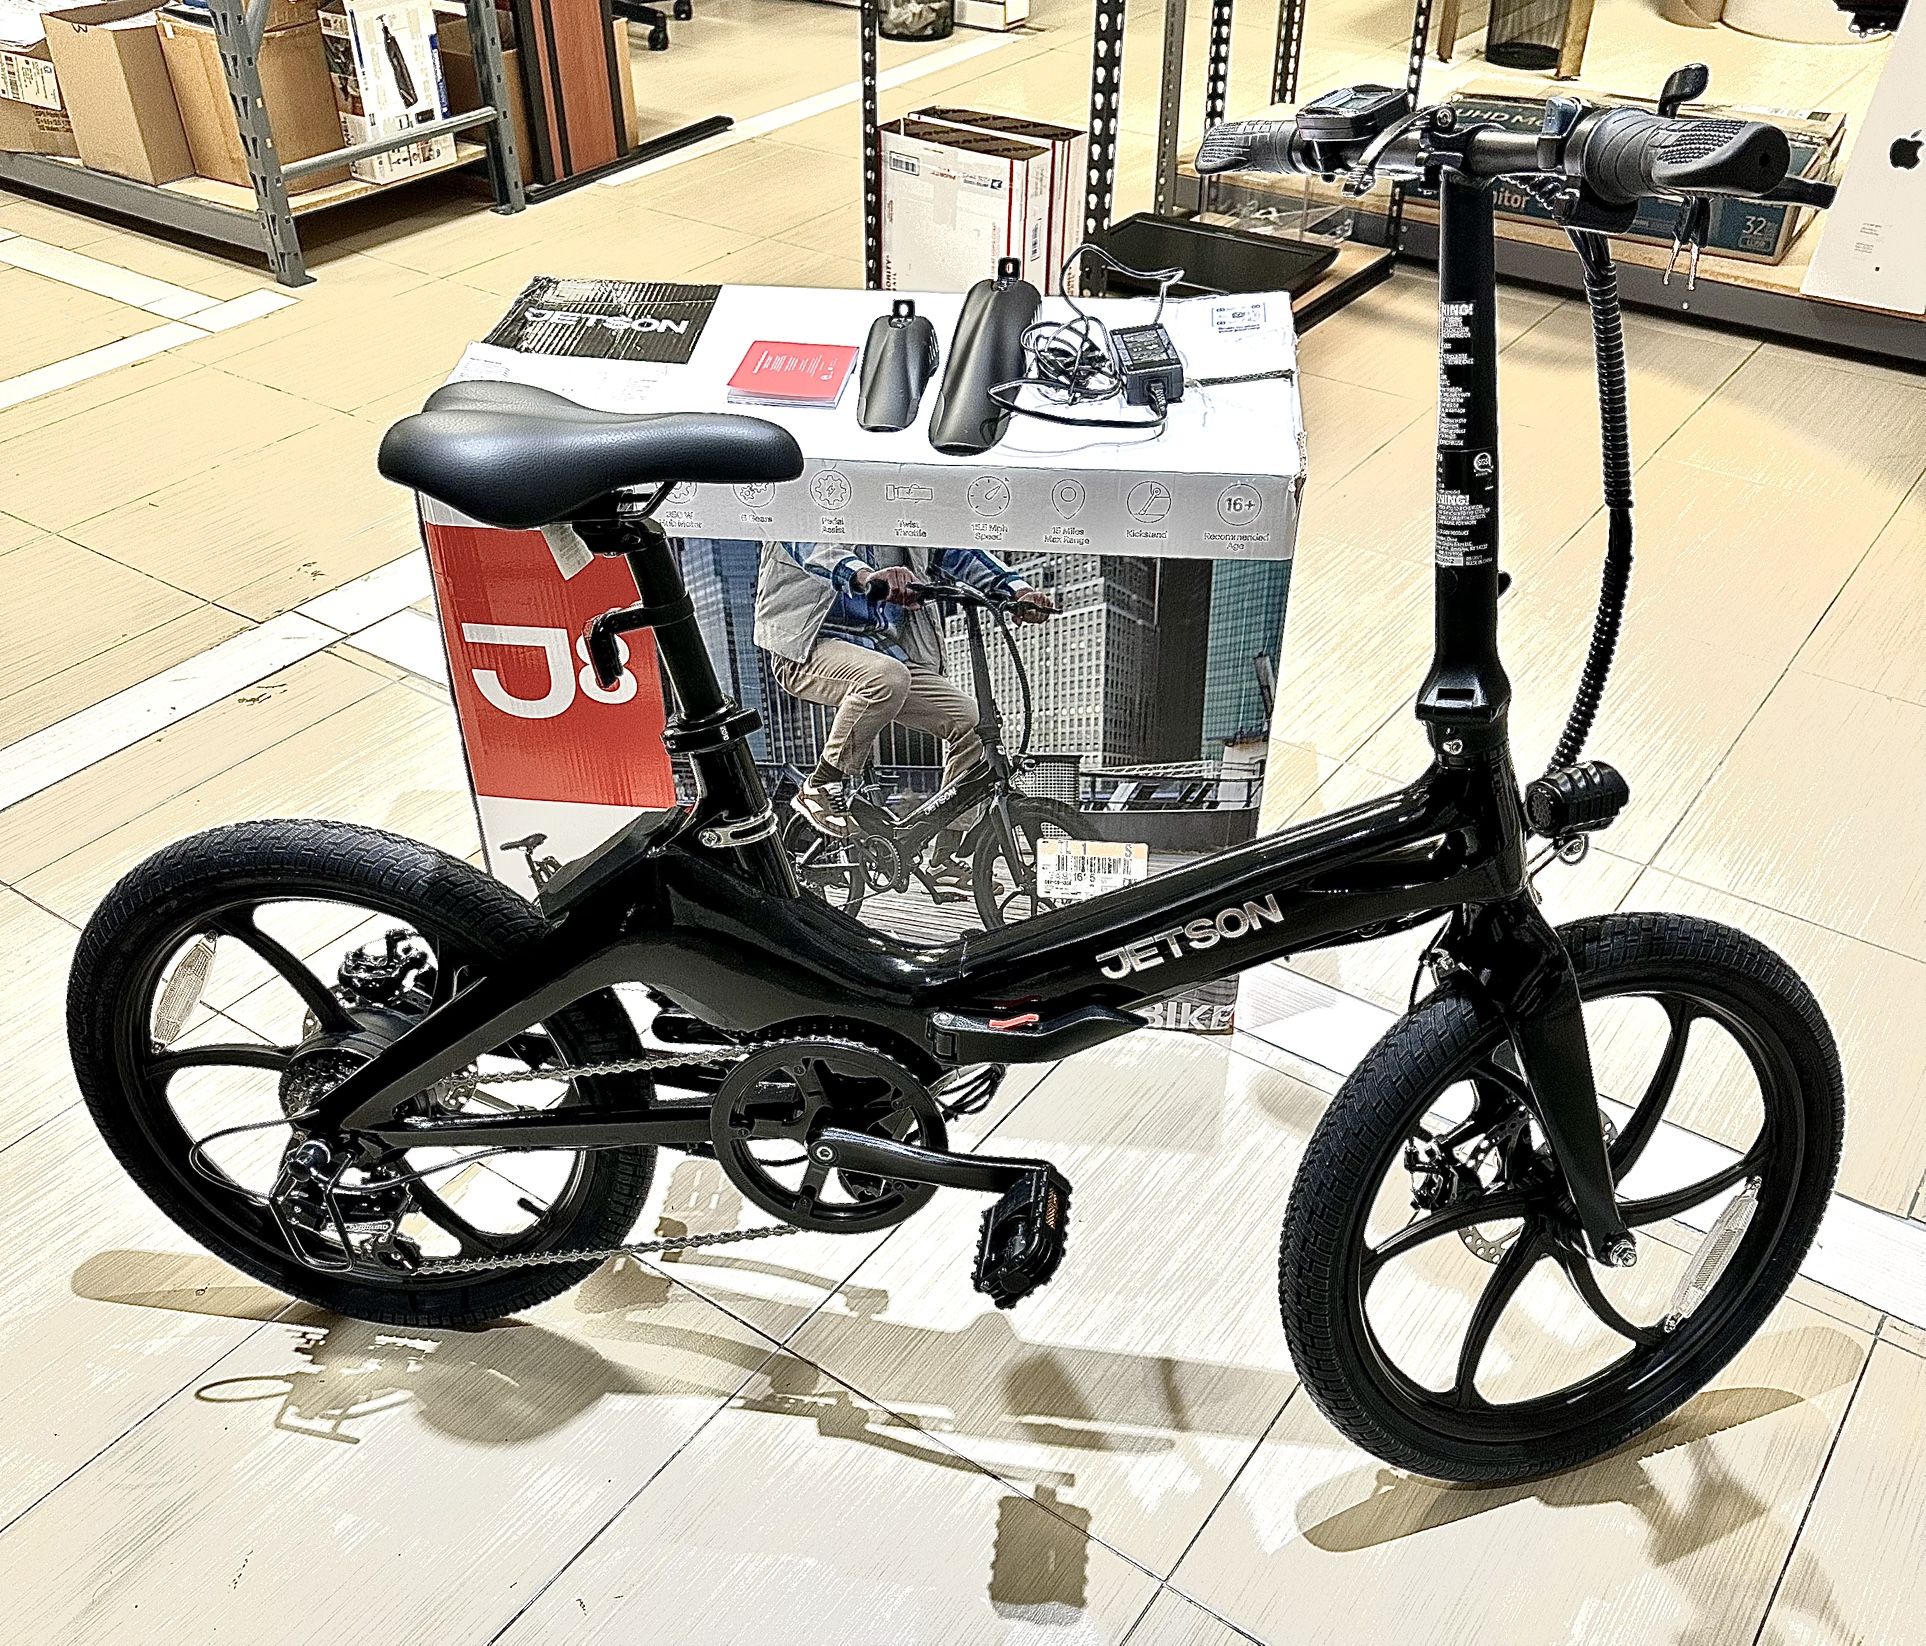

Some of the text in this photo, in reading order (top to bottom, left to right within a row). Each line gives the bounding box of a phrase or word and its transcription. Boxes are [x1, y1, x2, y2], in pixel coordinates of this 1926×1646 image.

[1456, 108, 1510, 122] UHD
[1742, 215, 1767, 236] 32
[1441, 303, 1474, 316] NING!
[524, 307, 690, 335] JETSON
[1224, 497, 1256, 513] 16+
[1436, 493, 1470, 506] NING!
[821, 517, 845, 526] Pedal
[898, 519, 920, 529] Twist
[821, 526, 846, 535] Assist
[988, 524, 1009, 534] Mph
[1062, 527, 1085, 537] Miles
[1126, 529, 1169, 540] Kickstand
[974, 532, 1003, 542] Speed
[1044, 535, 1090, 546] Max Range
[1203, 531, 1270, 542] Recommended
[1226, 540, 1245, 551] Age
[1096, 894, 1285, 980] JETSON
[1141, 1001, 1235, 1031] BIKE
